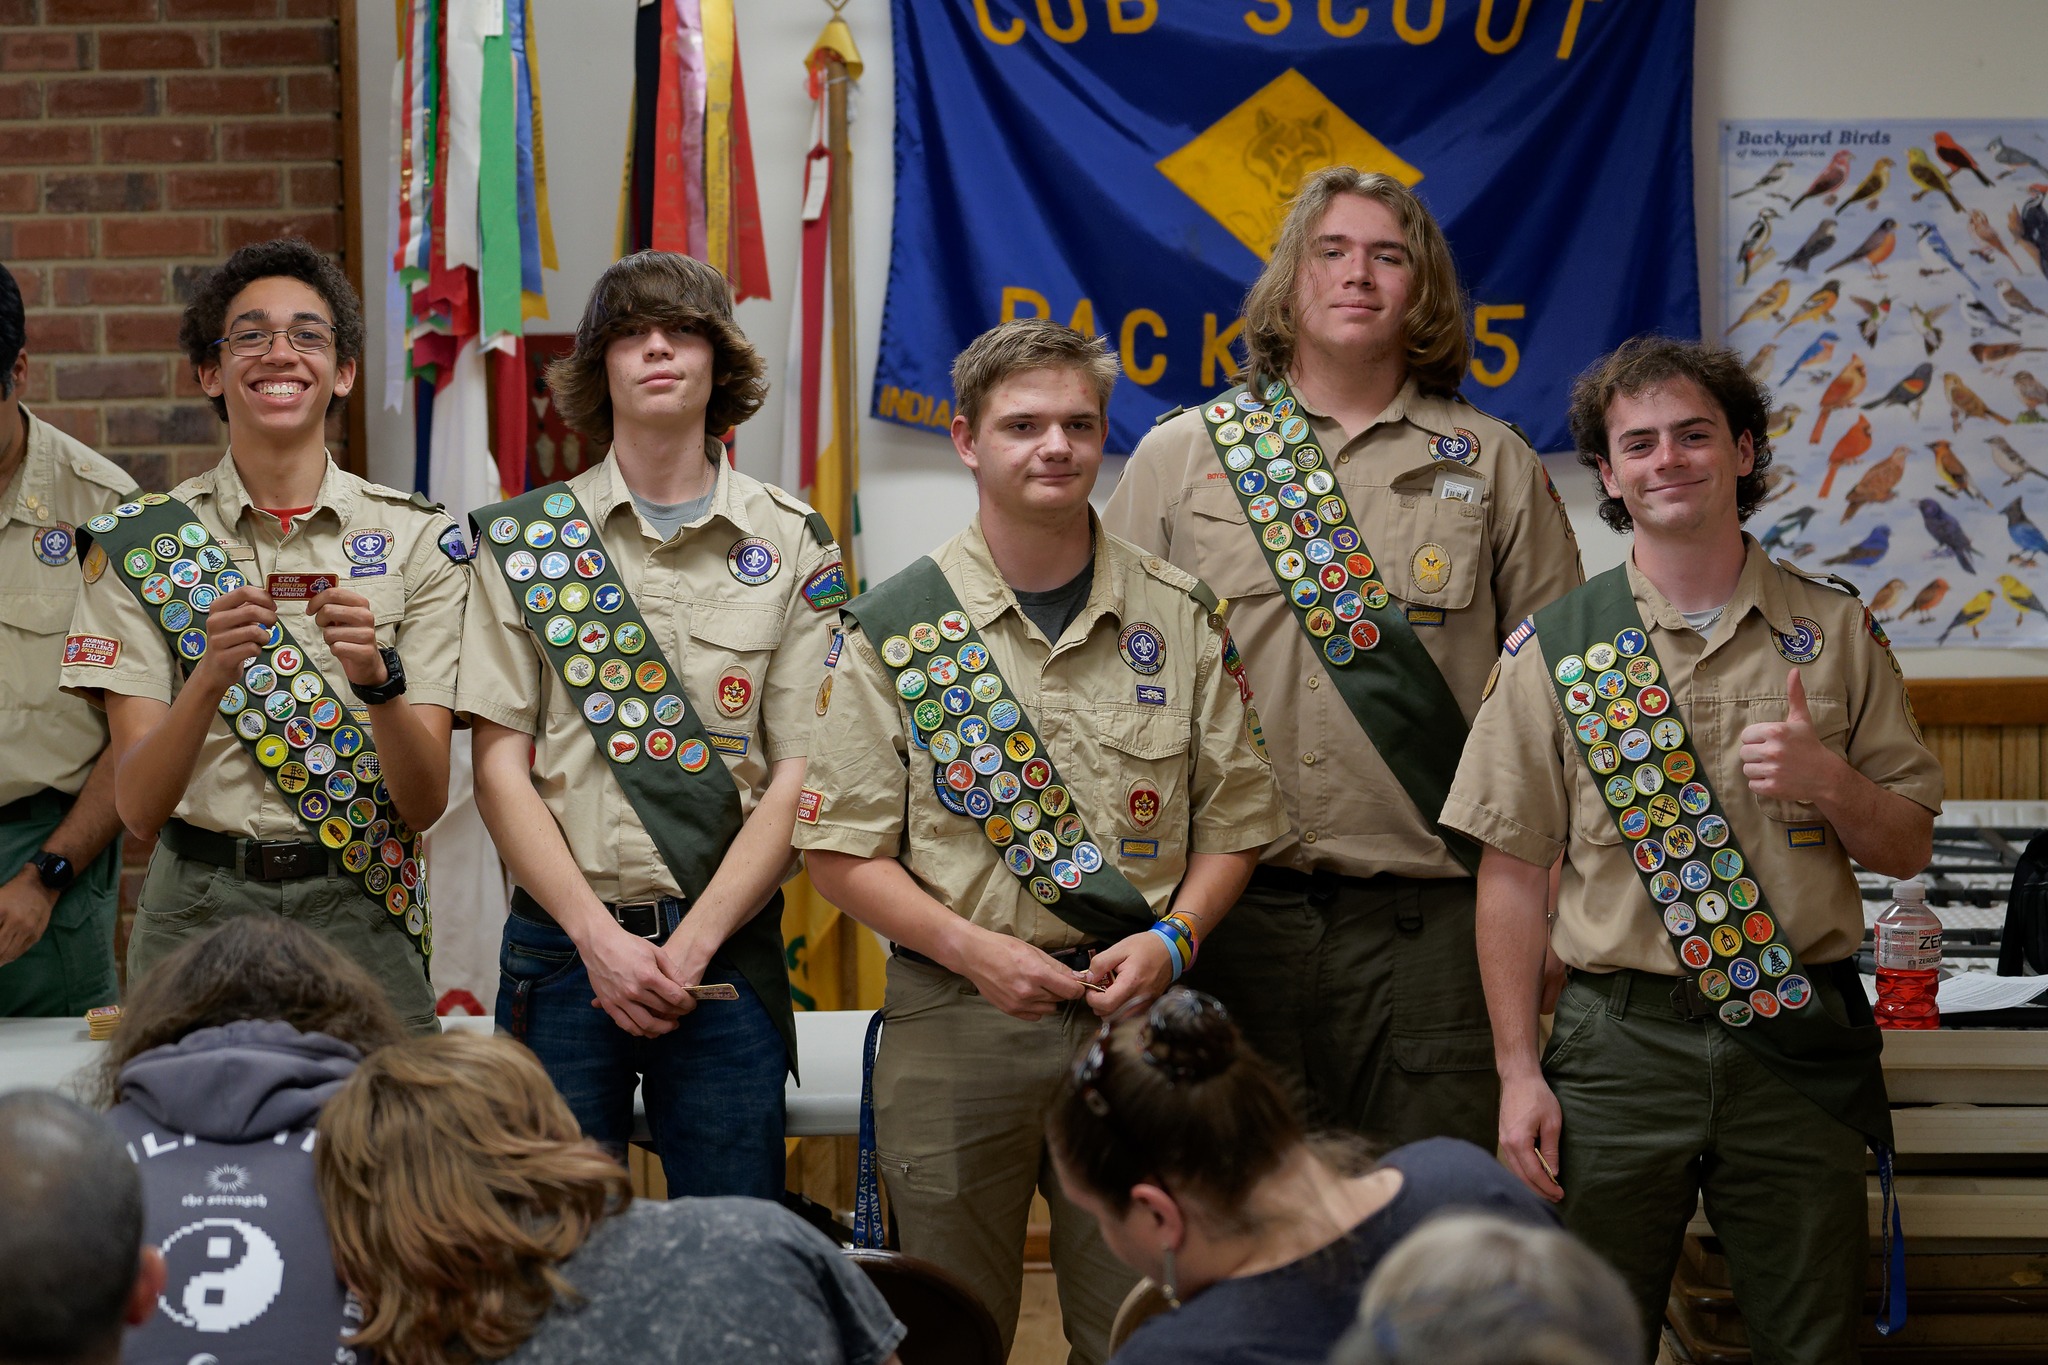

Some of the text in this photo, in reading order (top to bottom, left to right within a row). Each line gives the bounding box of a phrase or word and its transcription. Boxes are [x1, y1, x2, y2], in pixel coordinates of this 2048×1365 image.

[1738, 130, 1892, 148] Backyard Birds
[879, 384, 960, 430] INDIA
[810, 566, 837, 590] PALMETTO
[820, 595, 844, 606] SOUTH
[1800, 619, 1821, 638] AMERICA
[82, 642, 115, 653] EXCELLENCE
[83, 638, 108, 646] JOURNEY
[85, 653, 107, 664] 2022
[94, 649, 114, 657] AWARD
[869, 1183, 885, 1249] LANCAST
